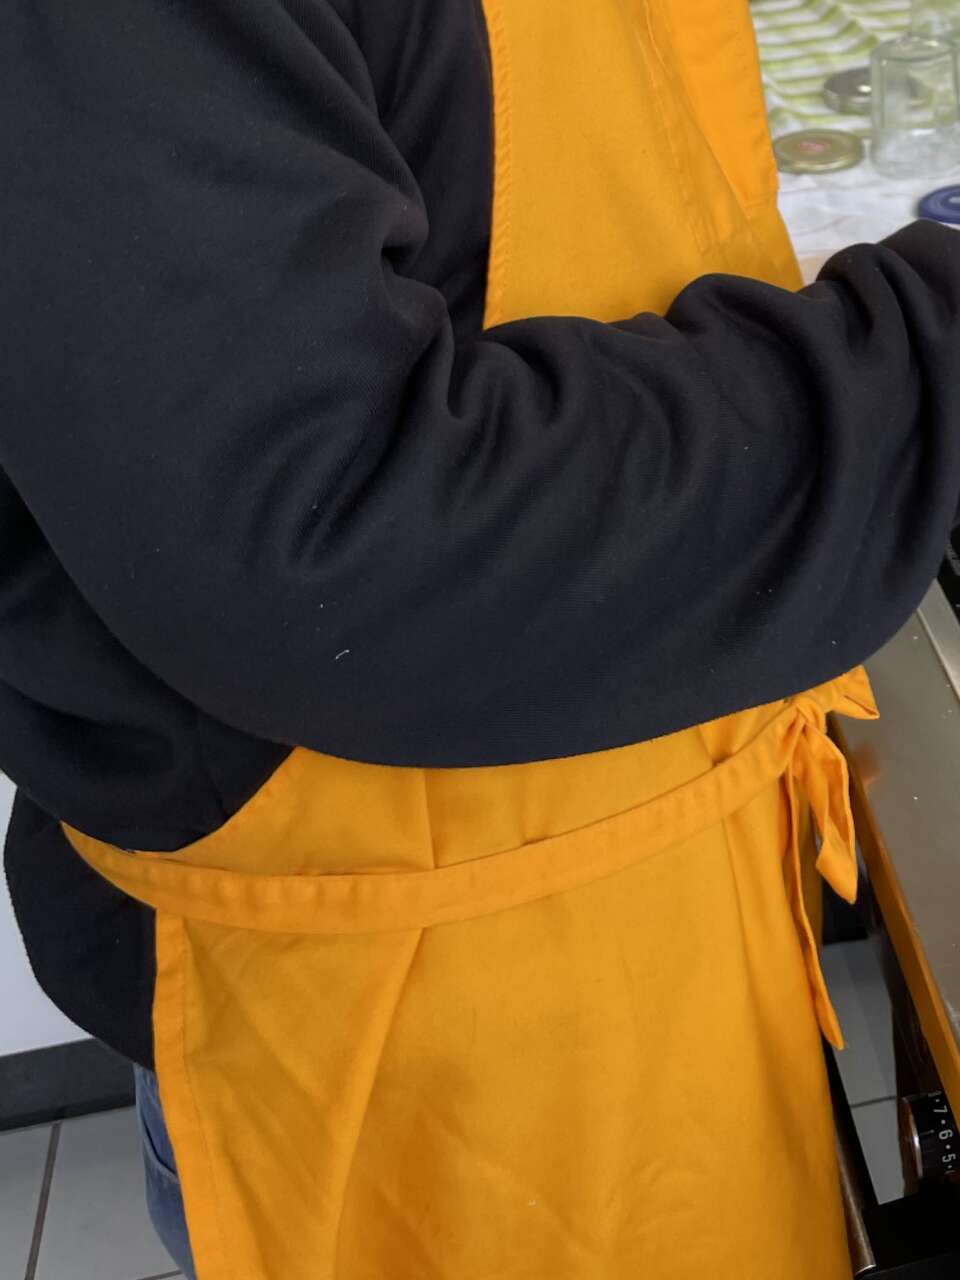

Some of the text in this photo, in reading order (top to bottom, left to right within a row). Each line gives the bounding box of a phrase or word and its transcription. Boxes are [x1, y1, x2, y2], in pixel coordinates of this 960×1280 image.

[933, 1105, 948, 1114] 7
[938, 1129, 952, 1139] 6
[942, 1153, 956, 1163] 5
